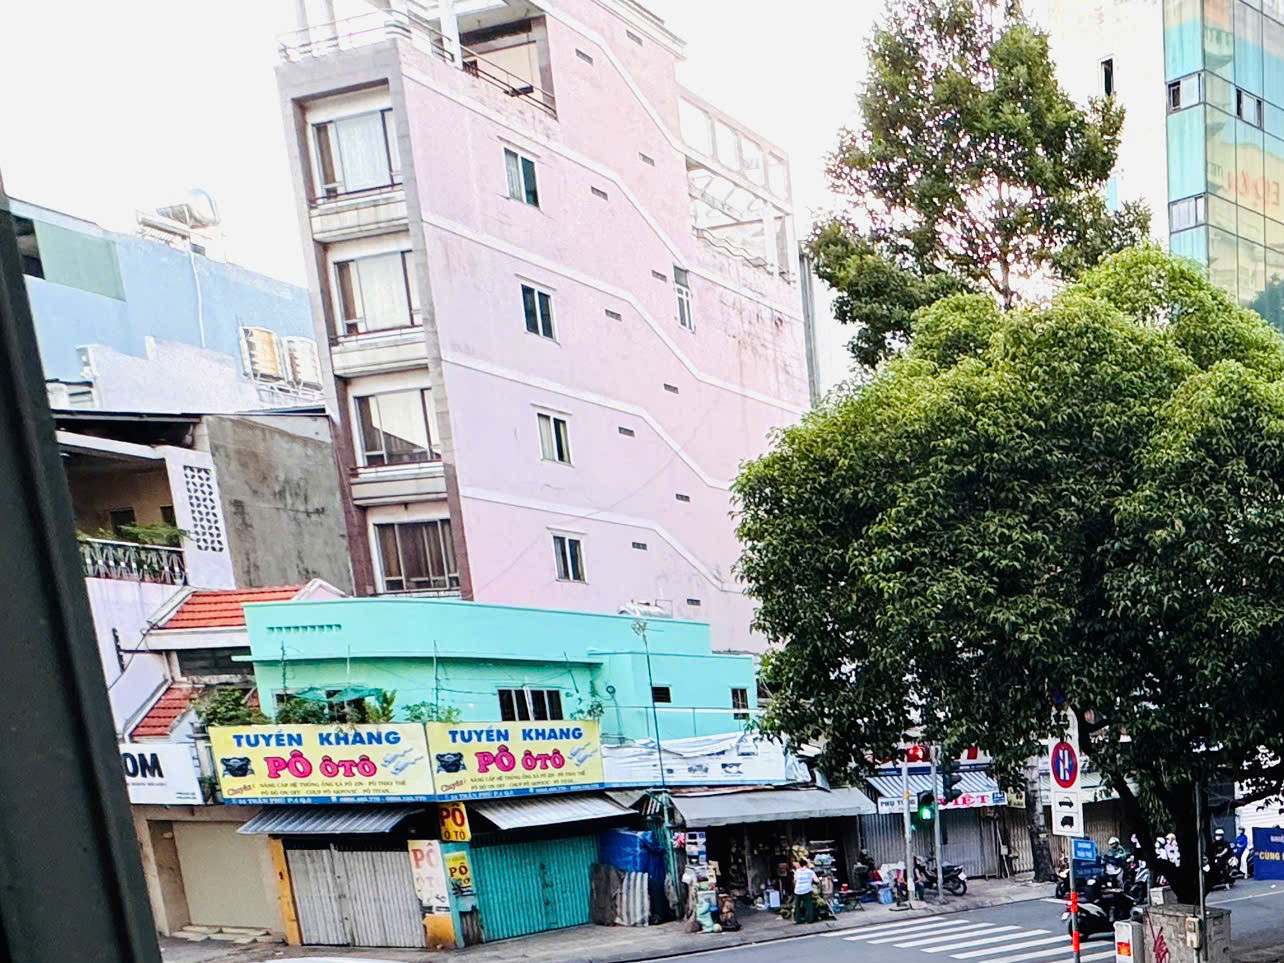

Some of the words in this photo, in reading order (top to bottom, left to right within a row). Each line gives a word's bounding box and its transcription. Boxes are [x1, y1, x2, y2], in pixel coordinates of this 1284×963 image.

[318, 730, 400, 746] KHANG
[522, 727, 583, 741] KHANG
[264, 749, 312, 778] PÔ
[475, 744, 515, 773] PÔ
[441, 802, 466, 828] PÔ
